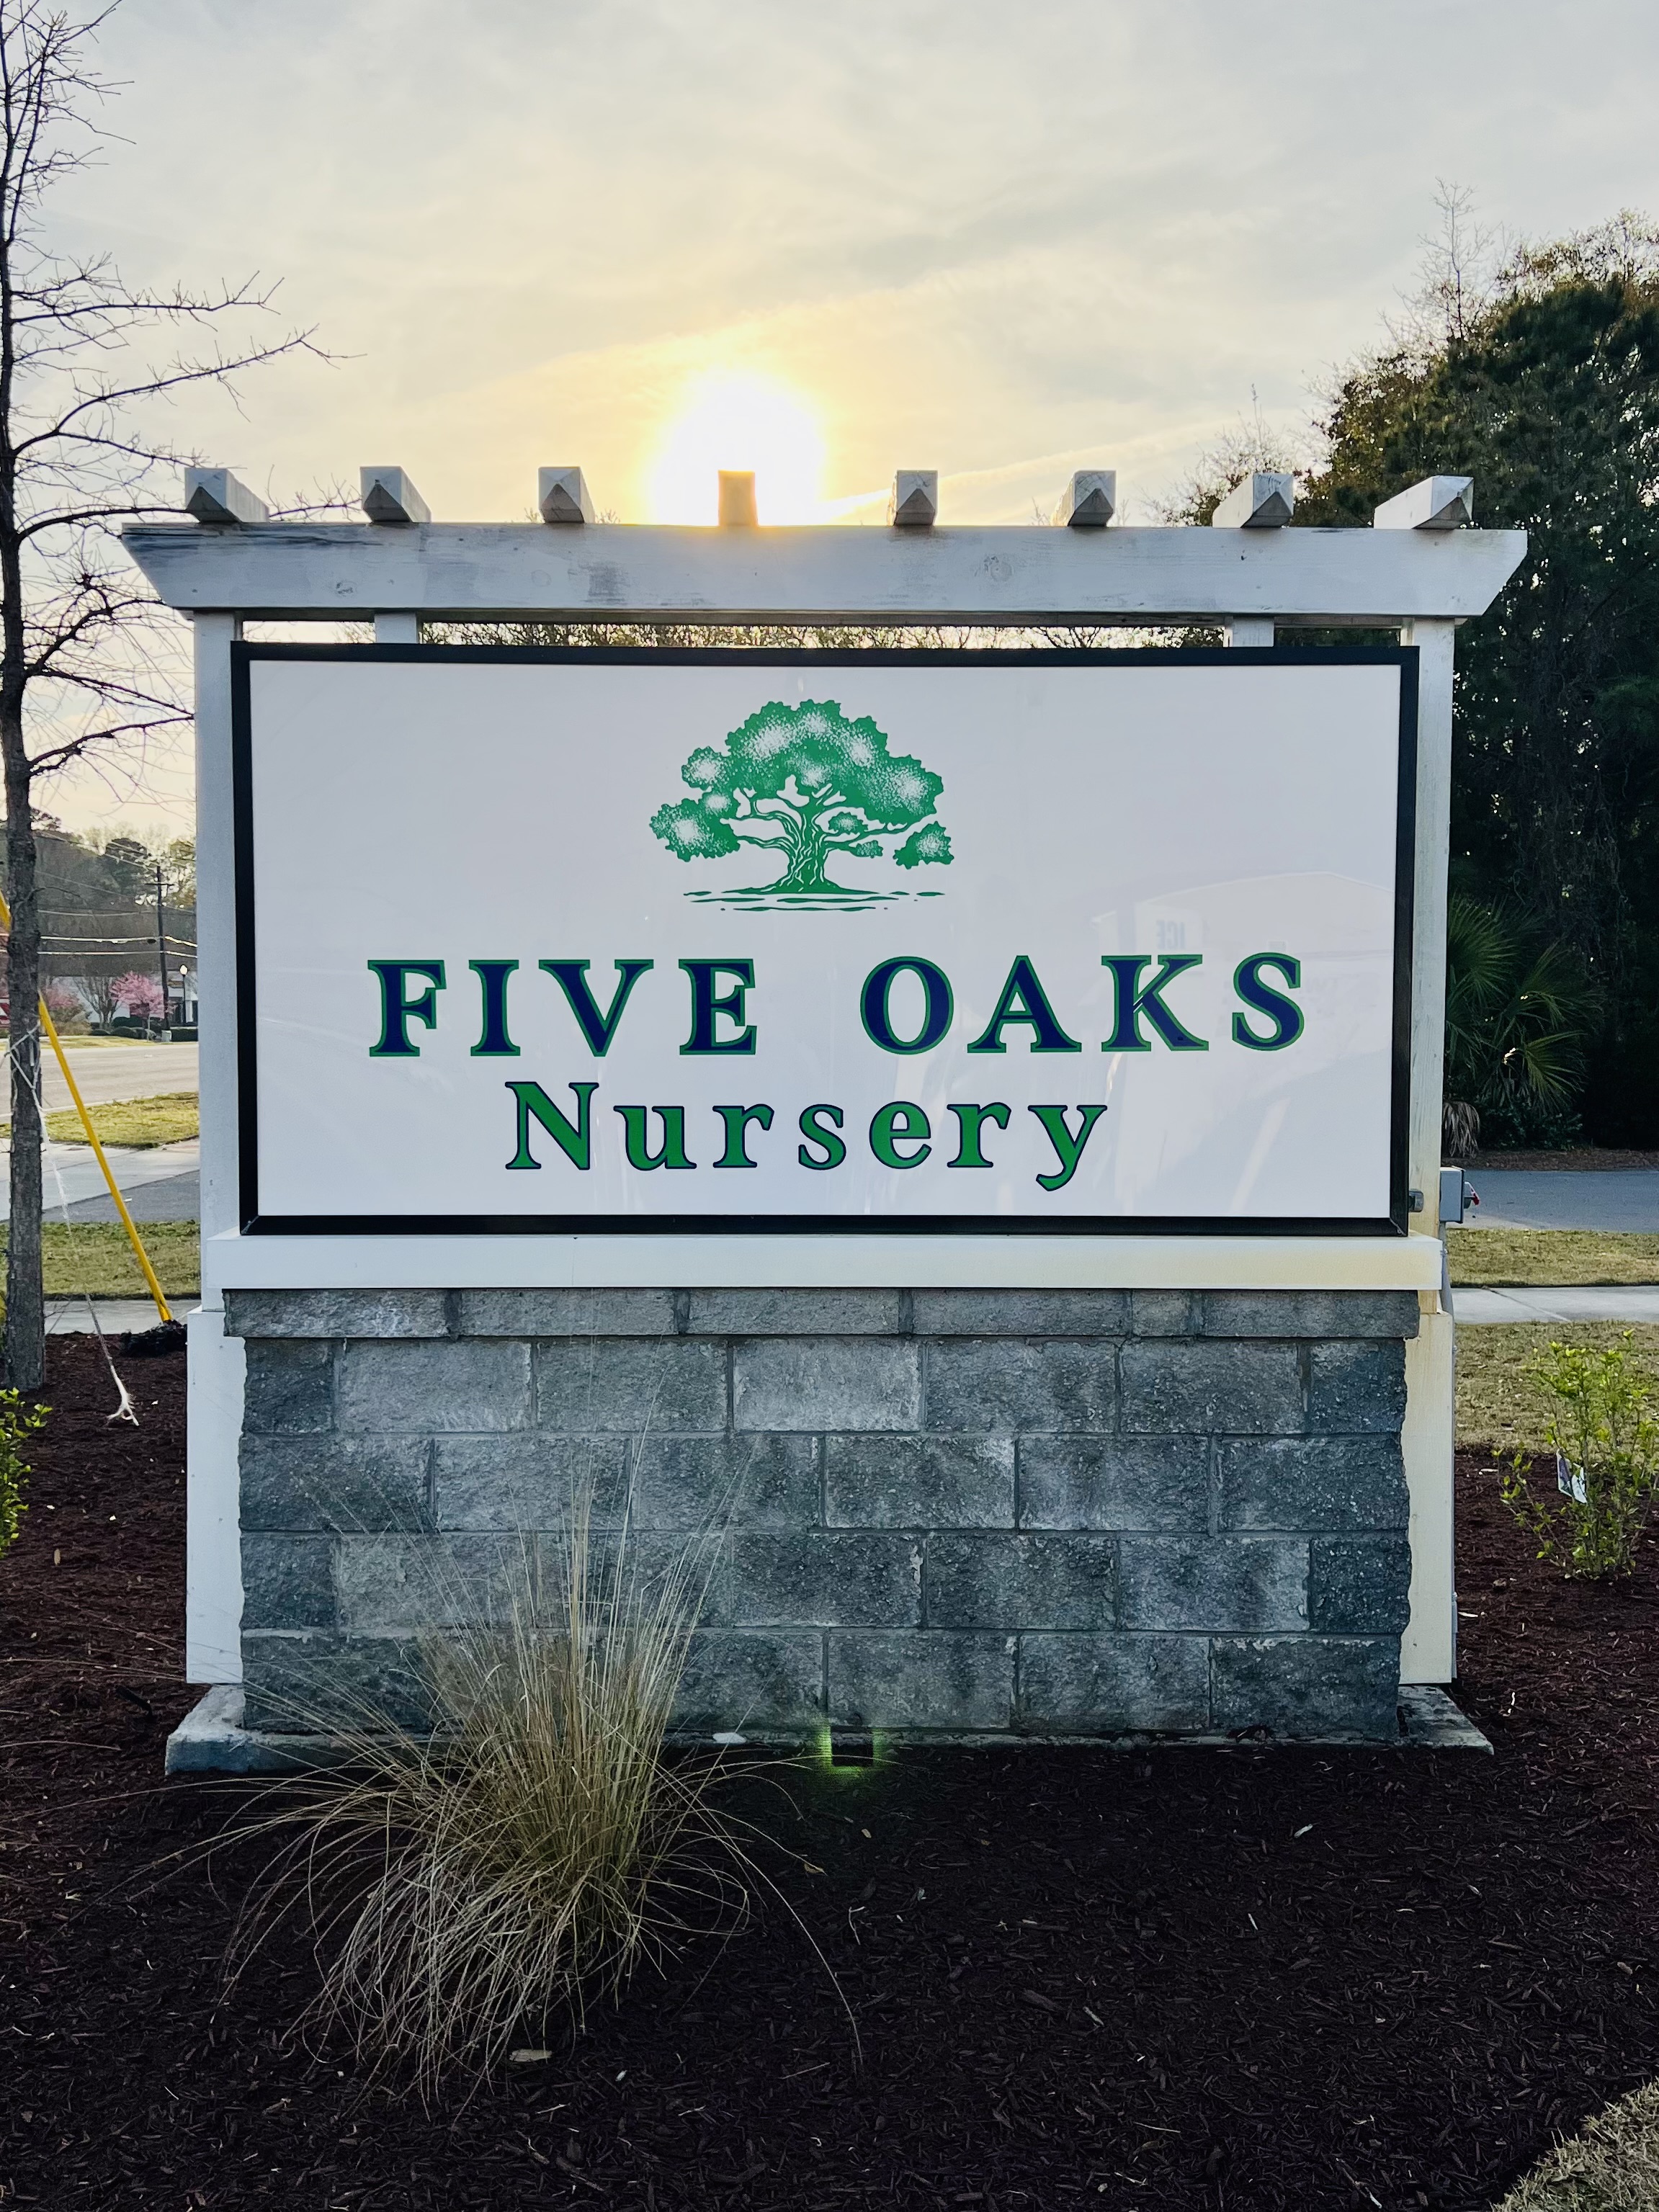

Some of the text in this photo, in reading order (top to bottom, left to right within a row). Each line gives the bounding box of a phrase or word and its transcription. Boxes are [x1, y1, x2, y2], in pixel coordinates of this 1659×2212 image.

[367, 952, 1304, 1057] FIVE OAKS
[505, 1081, 1107, 1191] Nursery
